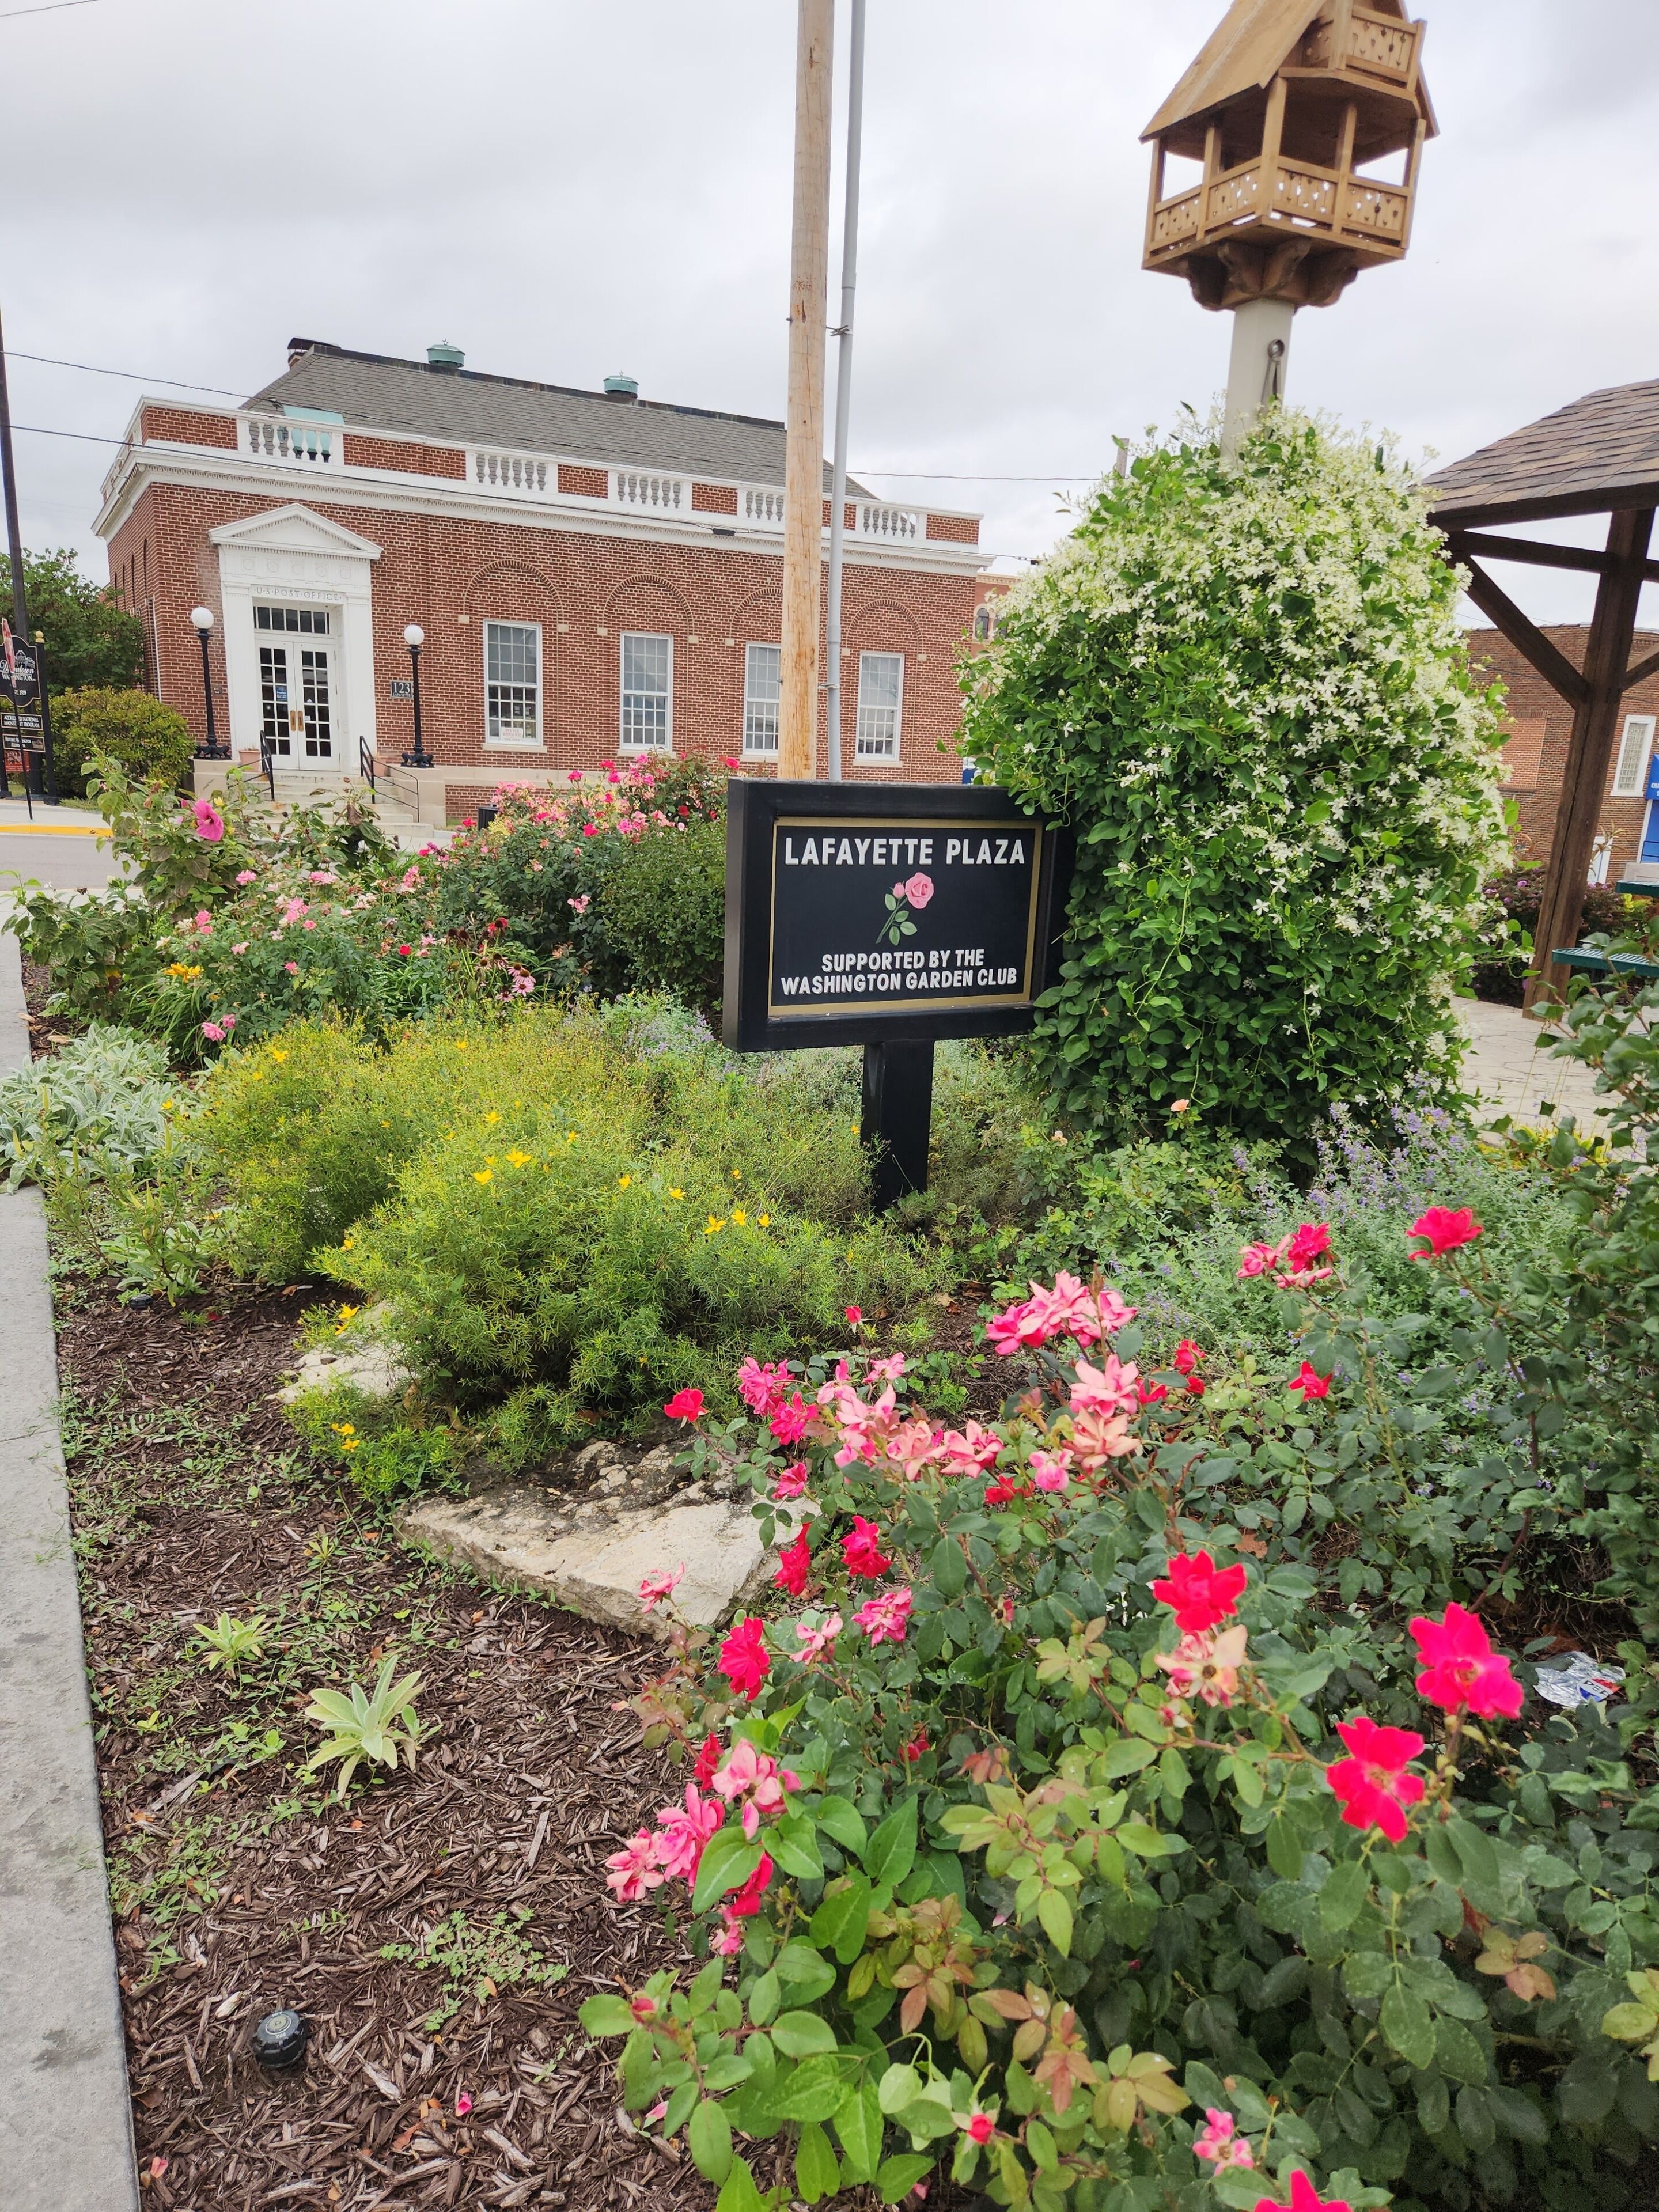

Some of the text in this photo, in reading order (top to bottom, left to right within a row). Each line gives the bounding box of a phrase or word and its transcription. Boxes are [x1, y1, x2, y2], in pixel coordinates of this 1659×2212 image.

[275, 588, 300, 598] POST
[304, 590, 339, 601] OFFICE
[393, 682, 410, 694] 123
[785, 837, 1025, 866] LAFAYETTE PLAZA
[821, 948, 985, 973] SUPPORTED BY THE
[781, 967, 1018, 996] WASHINGTON GARDEN CLUB
